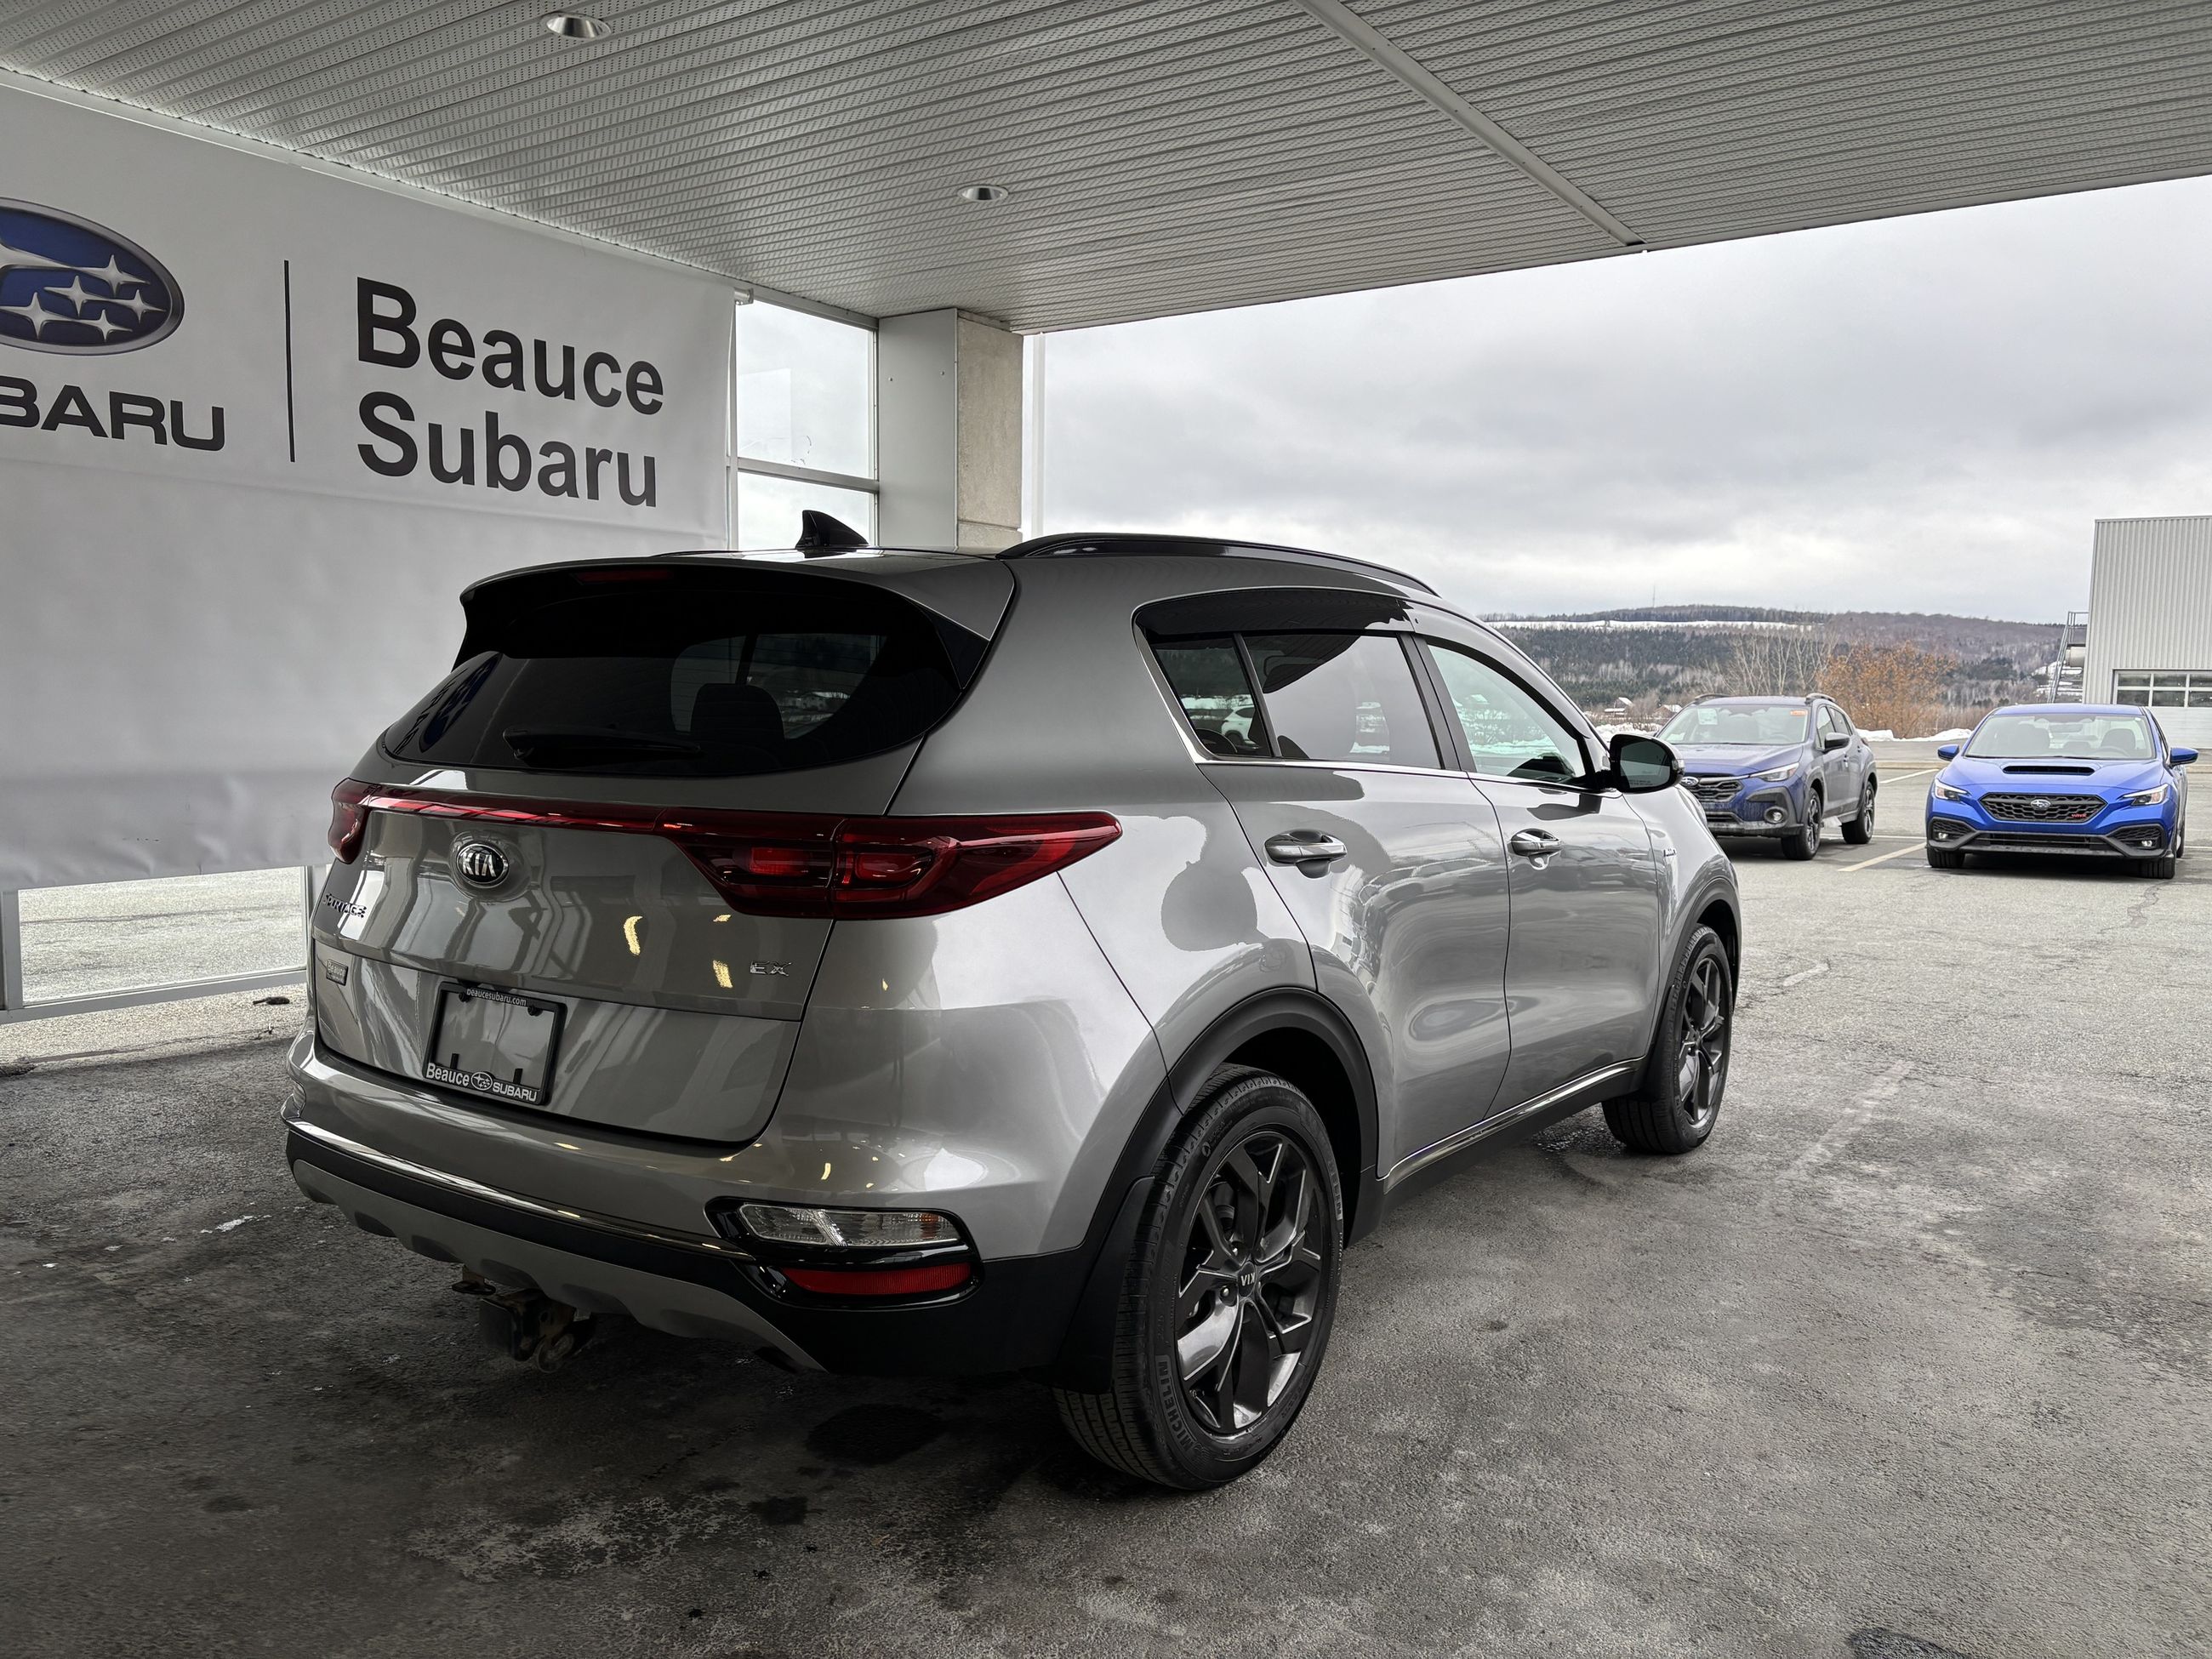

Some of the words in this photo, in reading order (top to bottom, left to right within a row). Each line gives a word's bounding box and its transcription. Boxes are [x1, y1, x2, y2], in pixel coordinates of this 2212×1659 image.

[357, 276, 664, 415] Beauce
[357, 391, 657, 508] Subaru
[462, 852, 497, 877] KIA
[750, 961, 792, 978] EX
[466, 988, 527, 1007] beaucesubaru.com
[425, 1062, 470, 1087] Beauce
[492, 1081, 538, 1103] SUBARU
[1240, 1272, 1256, 1286] KIA
[1158, 1360, 1197, 1452] MICHELIN
